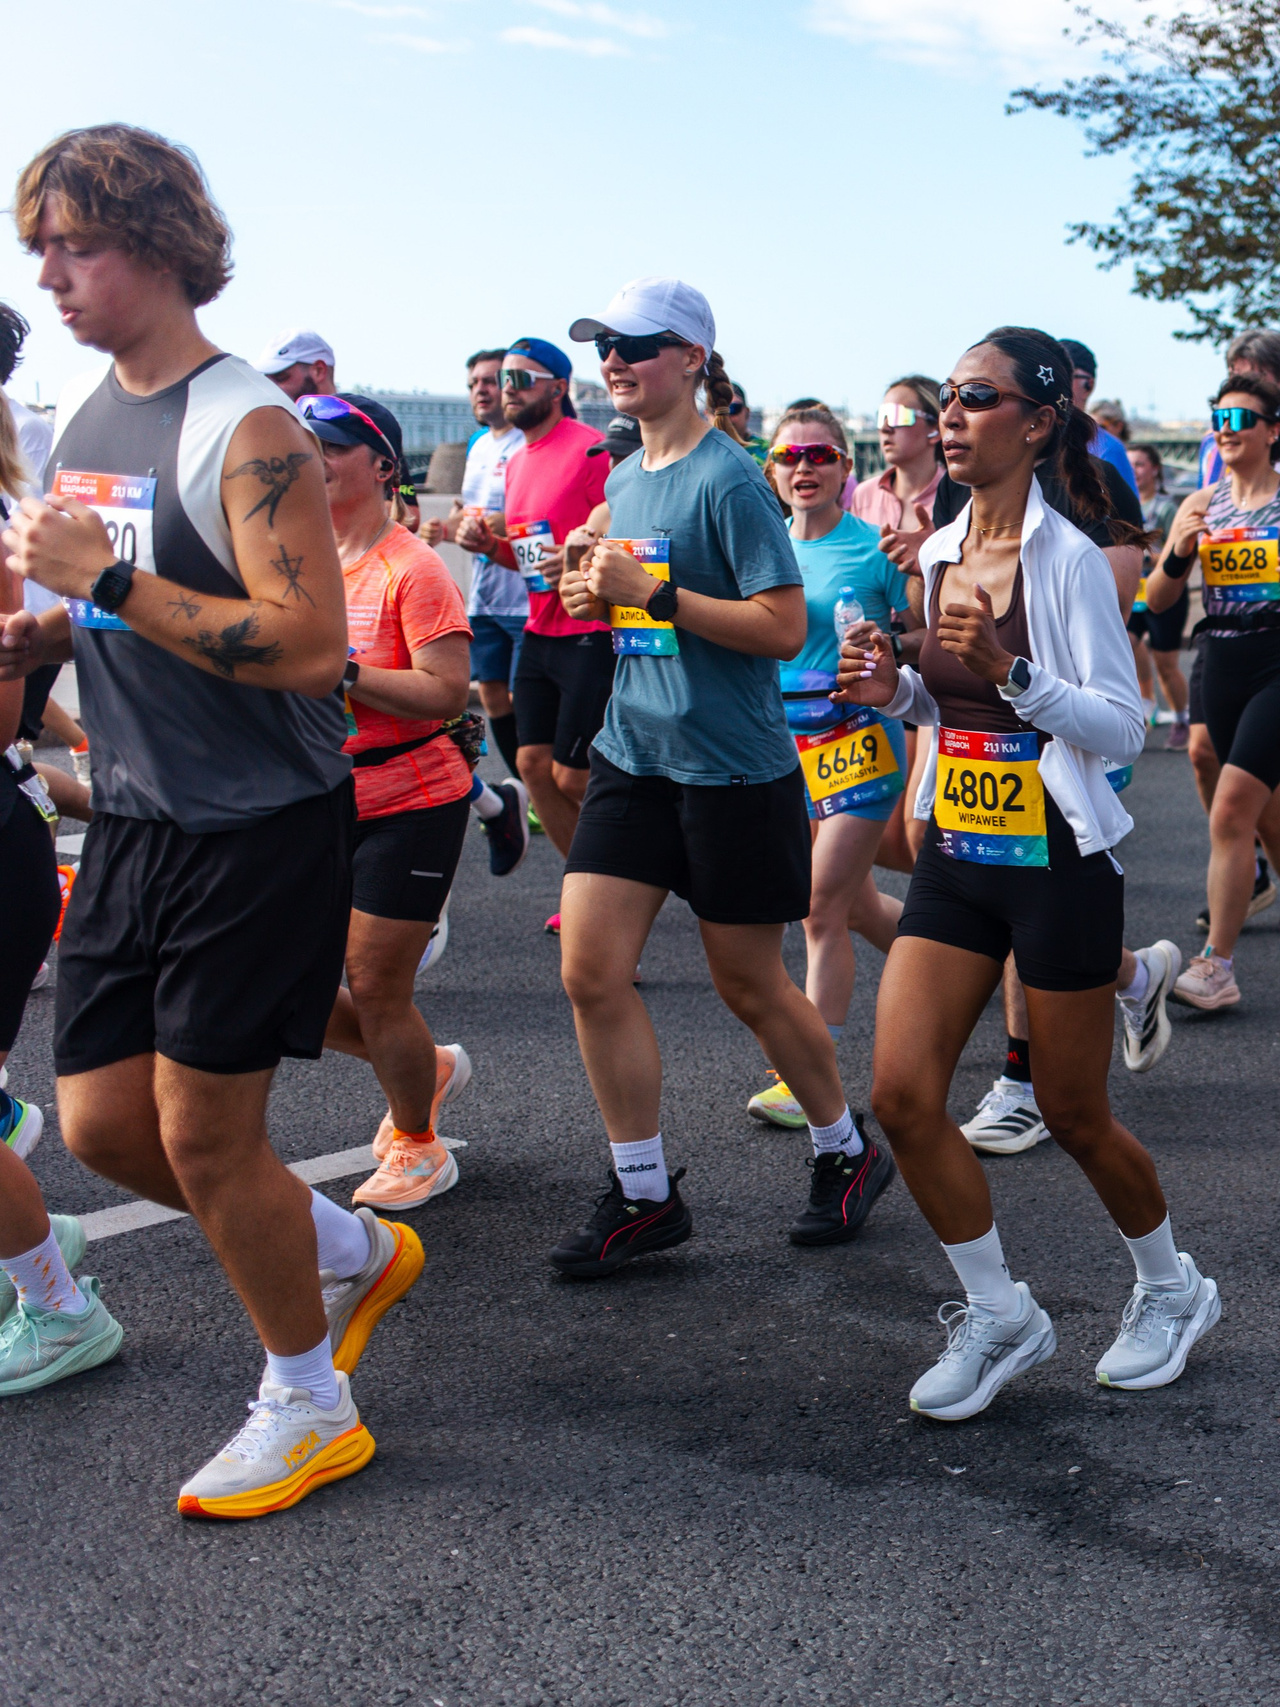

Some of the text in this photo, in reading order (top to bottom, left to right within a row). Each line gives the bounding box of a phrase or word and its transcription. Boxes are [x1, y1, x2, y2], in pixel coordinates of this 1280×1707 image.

[60, 484, 97, 495] МАРАФОН
[1209, 547, 1268, 572] 5628
[620, 611, 646, 621] АЛИСА
[817, 734, 878, 780] 6649
[983, 741, 1000, 754] 21,1
[828, 764, 880, 789] ANASTASIYA
[943, 768, 1025, 812] 4802
[958, 812, 1007, 827] WIPAWEE
[617, 1162, 658, 1173] adidas
[282, 1430, 321, 1470] HOKA
